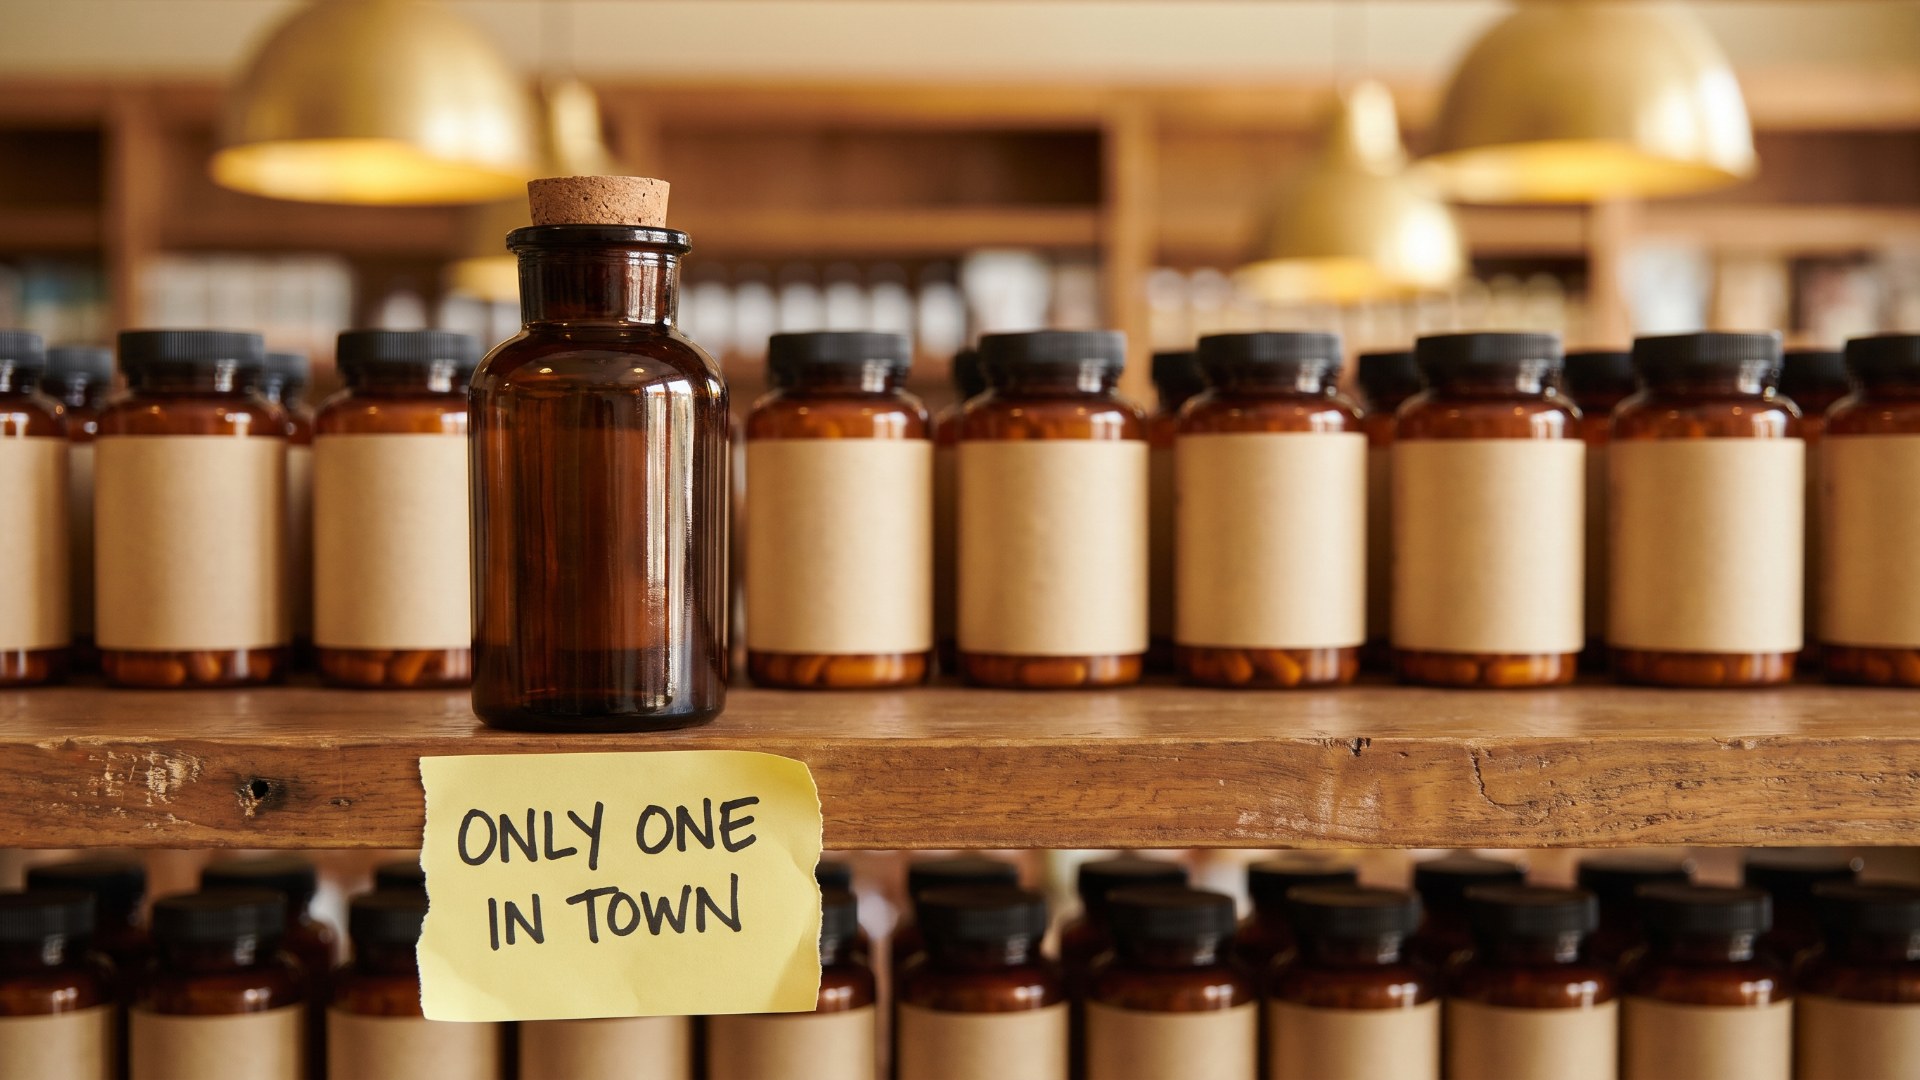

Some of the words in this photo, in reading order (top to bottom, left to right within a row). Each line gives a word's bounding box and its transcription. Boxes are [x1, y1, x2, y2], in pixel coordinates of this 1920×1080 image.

[457, 801, 604, 871] ONLY
[635, 797, 760, 855] ONE
[487, 893, 545, 951] IN
[565, 872, 742, 944] TOWN
